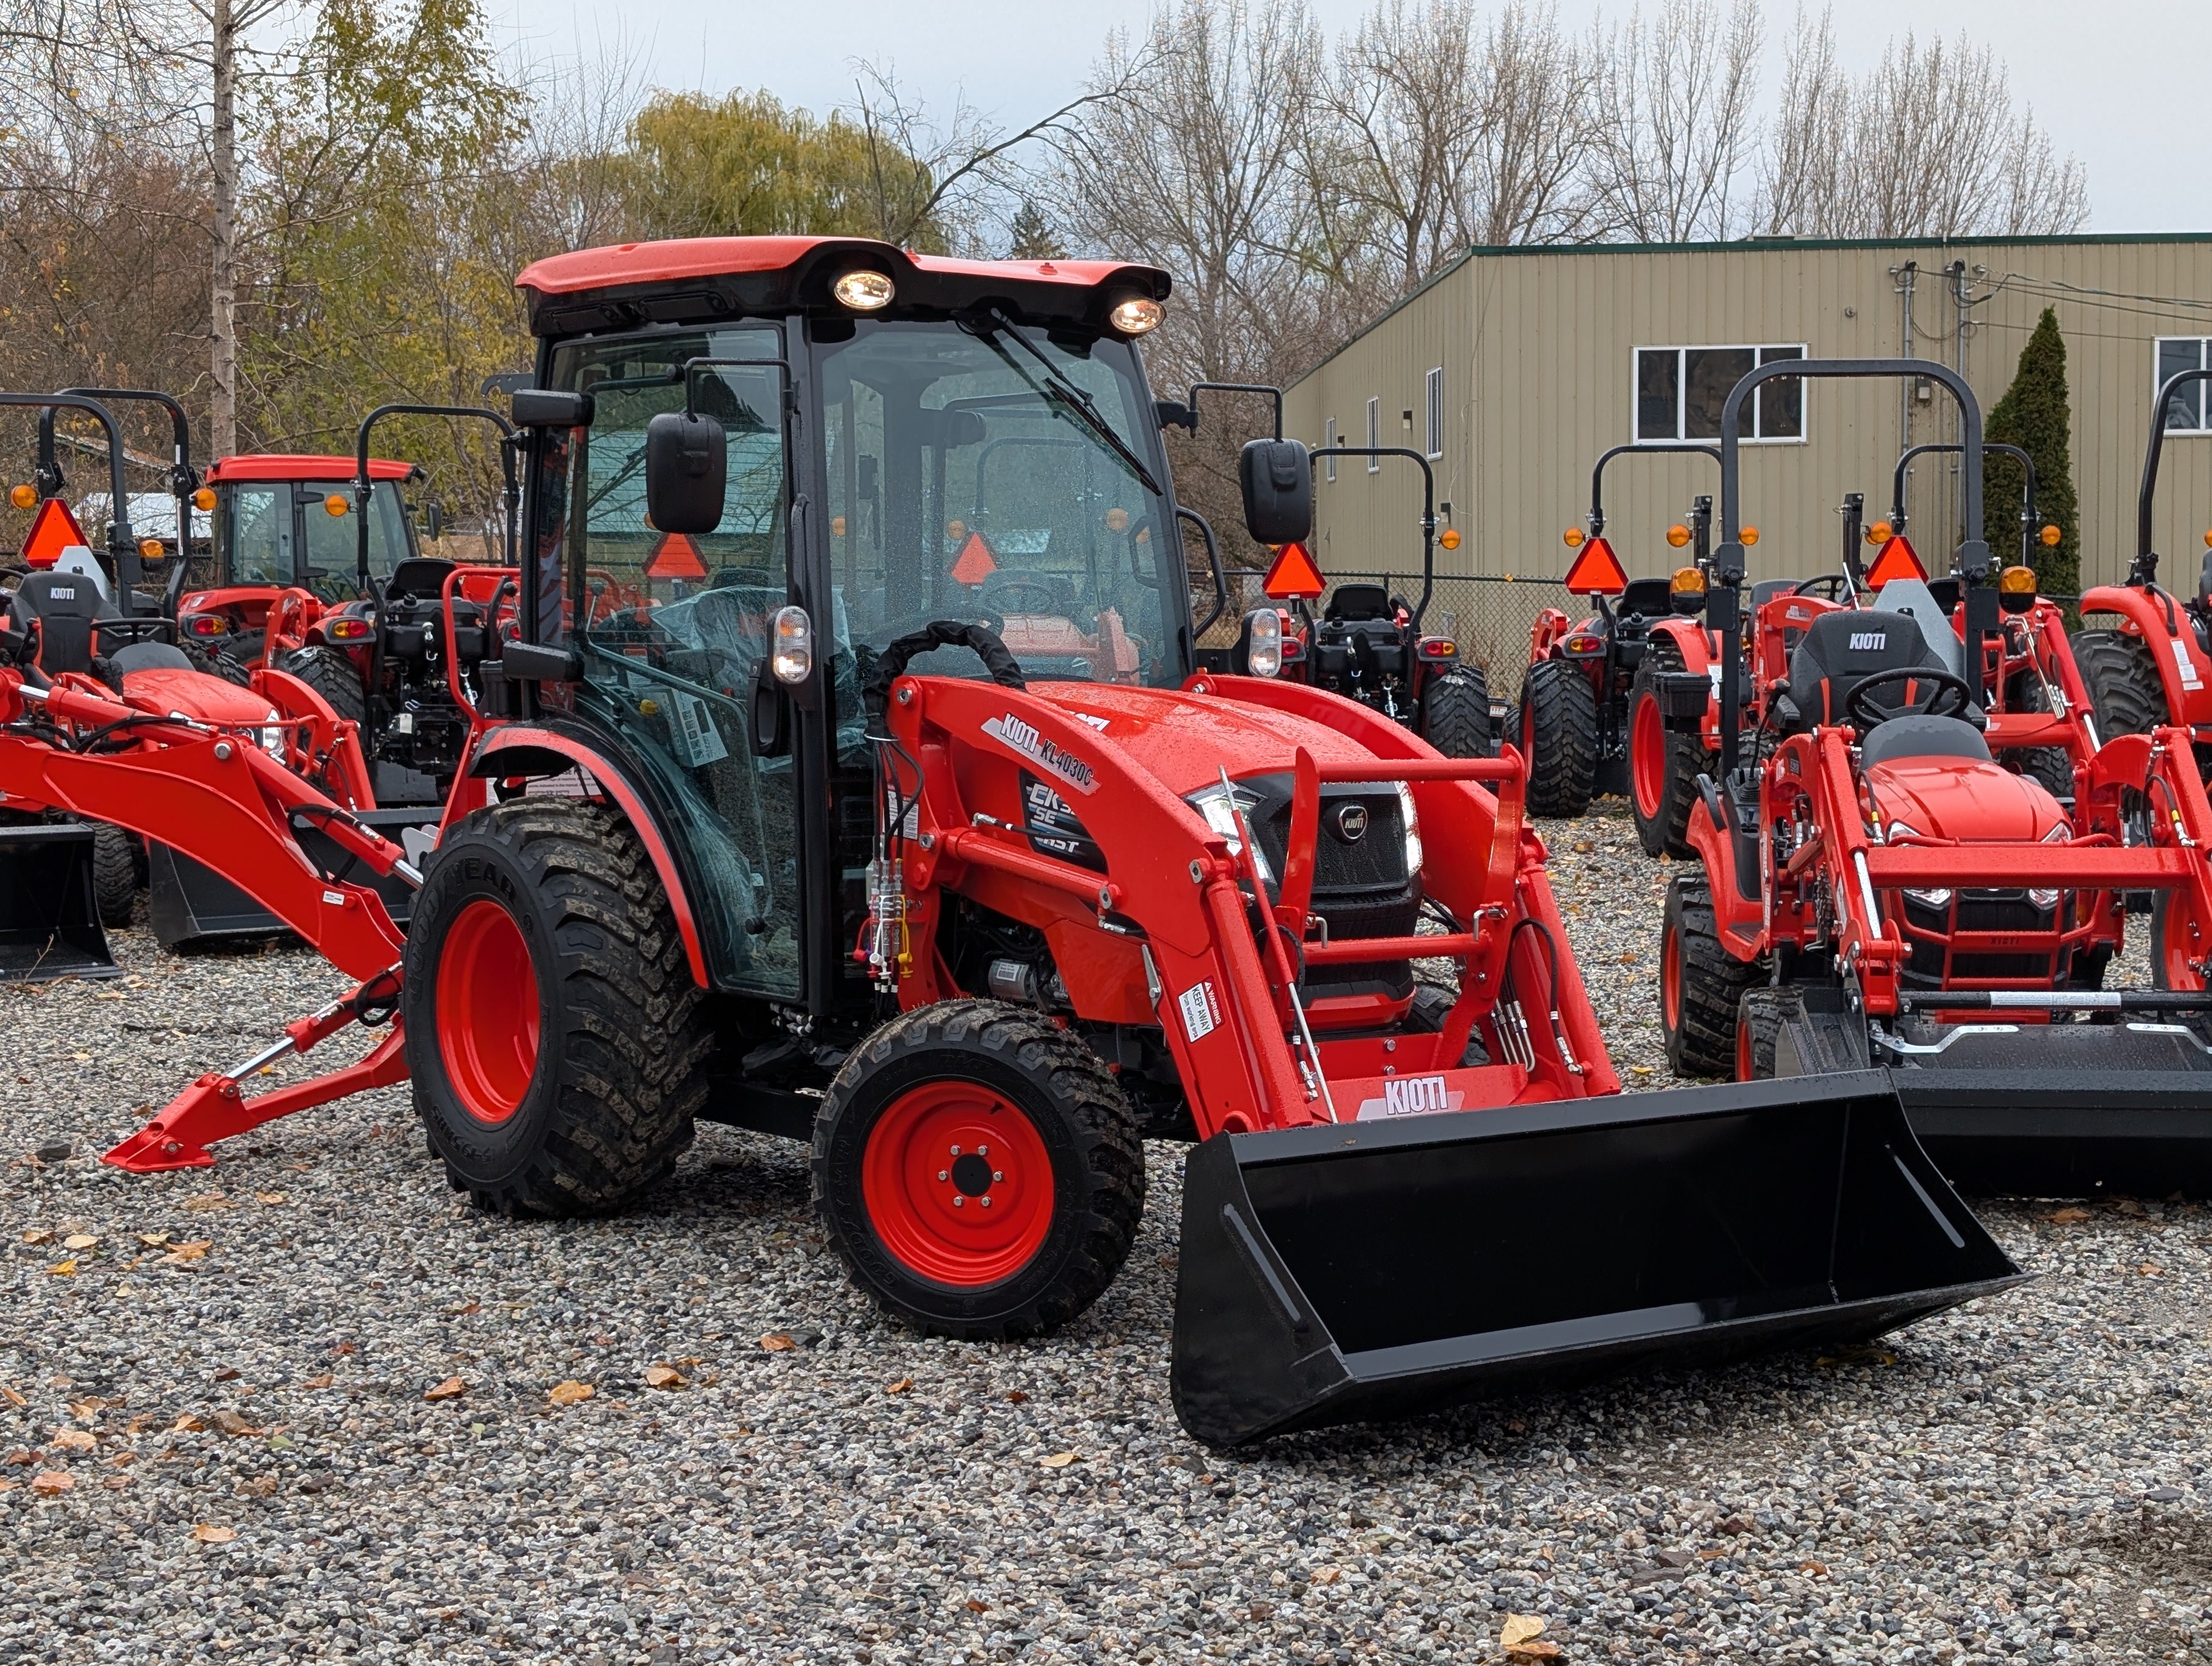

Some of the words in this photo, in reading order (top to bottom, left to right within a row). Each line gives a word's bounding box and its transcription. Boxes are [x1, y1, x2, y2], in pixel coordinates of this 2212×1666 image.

[50, 587, 75, 600] KIOTI
[1849, 633, 1886, 650] KIOTI
[1000, 712, 1040, 754] KIOTI
[1039, 738, 1094, 787] KL4030C
[1033, 806, 1057, 824] SE
[1345, 818, 1364, 829] KIOTI
[1192, 986, 1204, 1008] KEEP
[1208, 990, 1221, 1024] WARNING
[1197, 1009, 1211, 1031] AWAY
[1385, 1075, 1448, 1115] KIOTI
